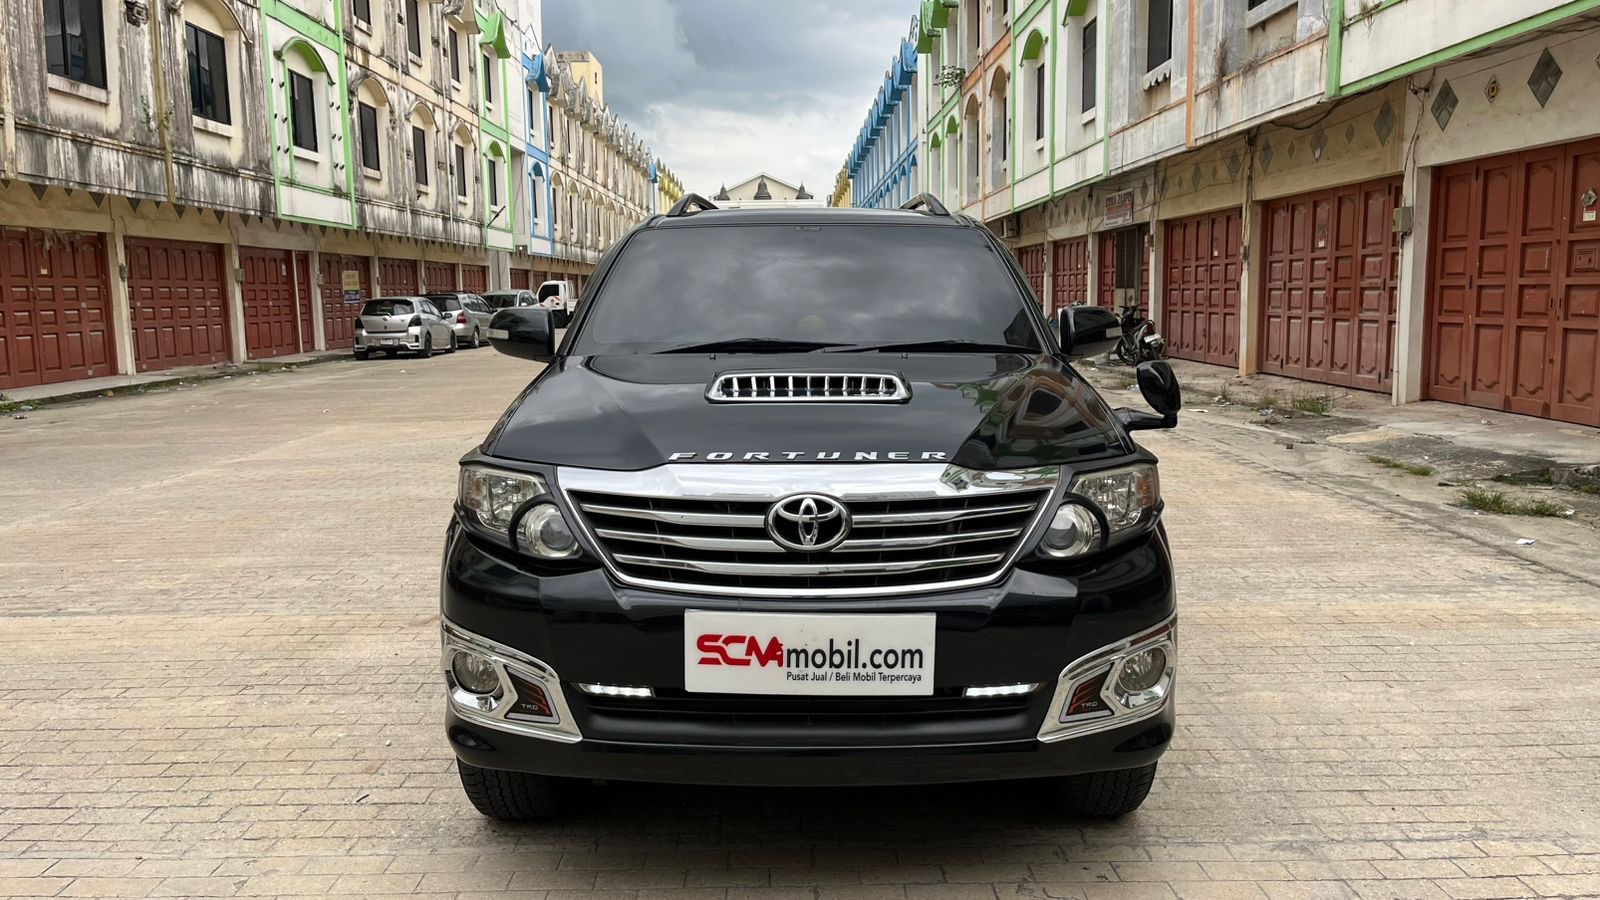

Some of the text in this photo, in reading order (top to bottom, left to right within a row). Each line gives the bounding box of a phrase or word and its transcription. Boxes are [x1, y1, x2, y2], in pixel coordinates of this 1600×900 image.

[667, 451, 947, 462] FORTUNER
[786, 671, 809, 682] Pusat
[811, 672, 828, 682] Jual
[835, 672, 851, 682] Beli
[853, 672, 876, 682] Mobil
[878, 672, 922, 684] Terpercaya
